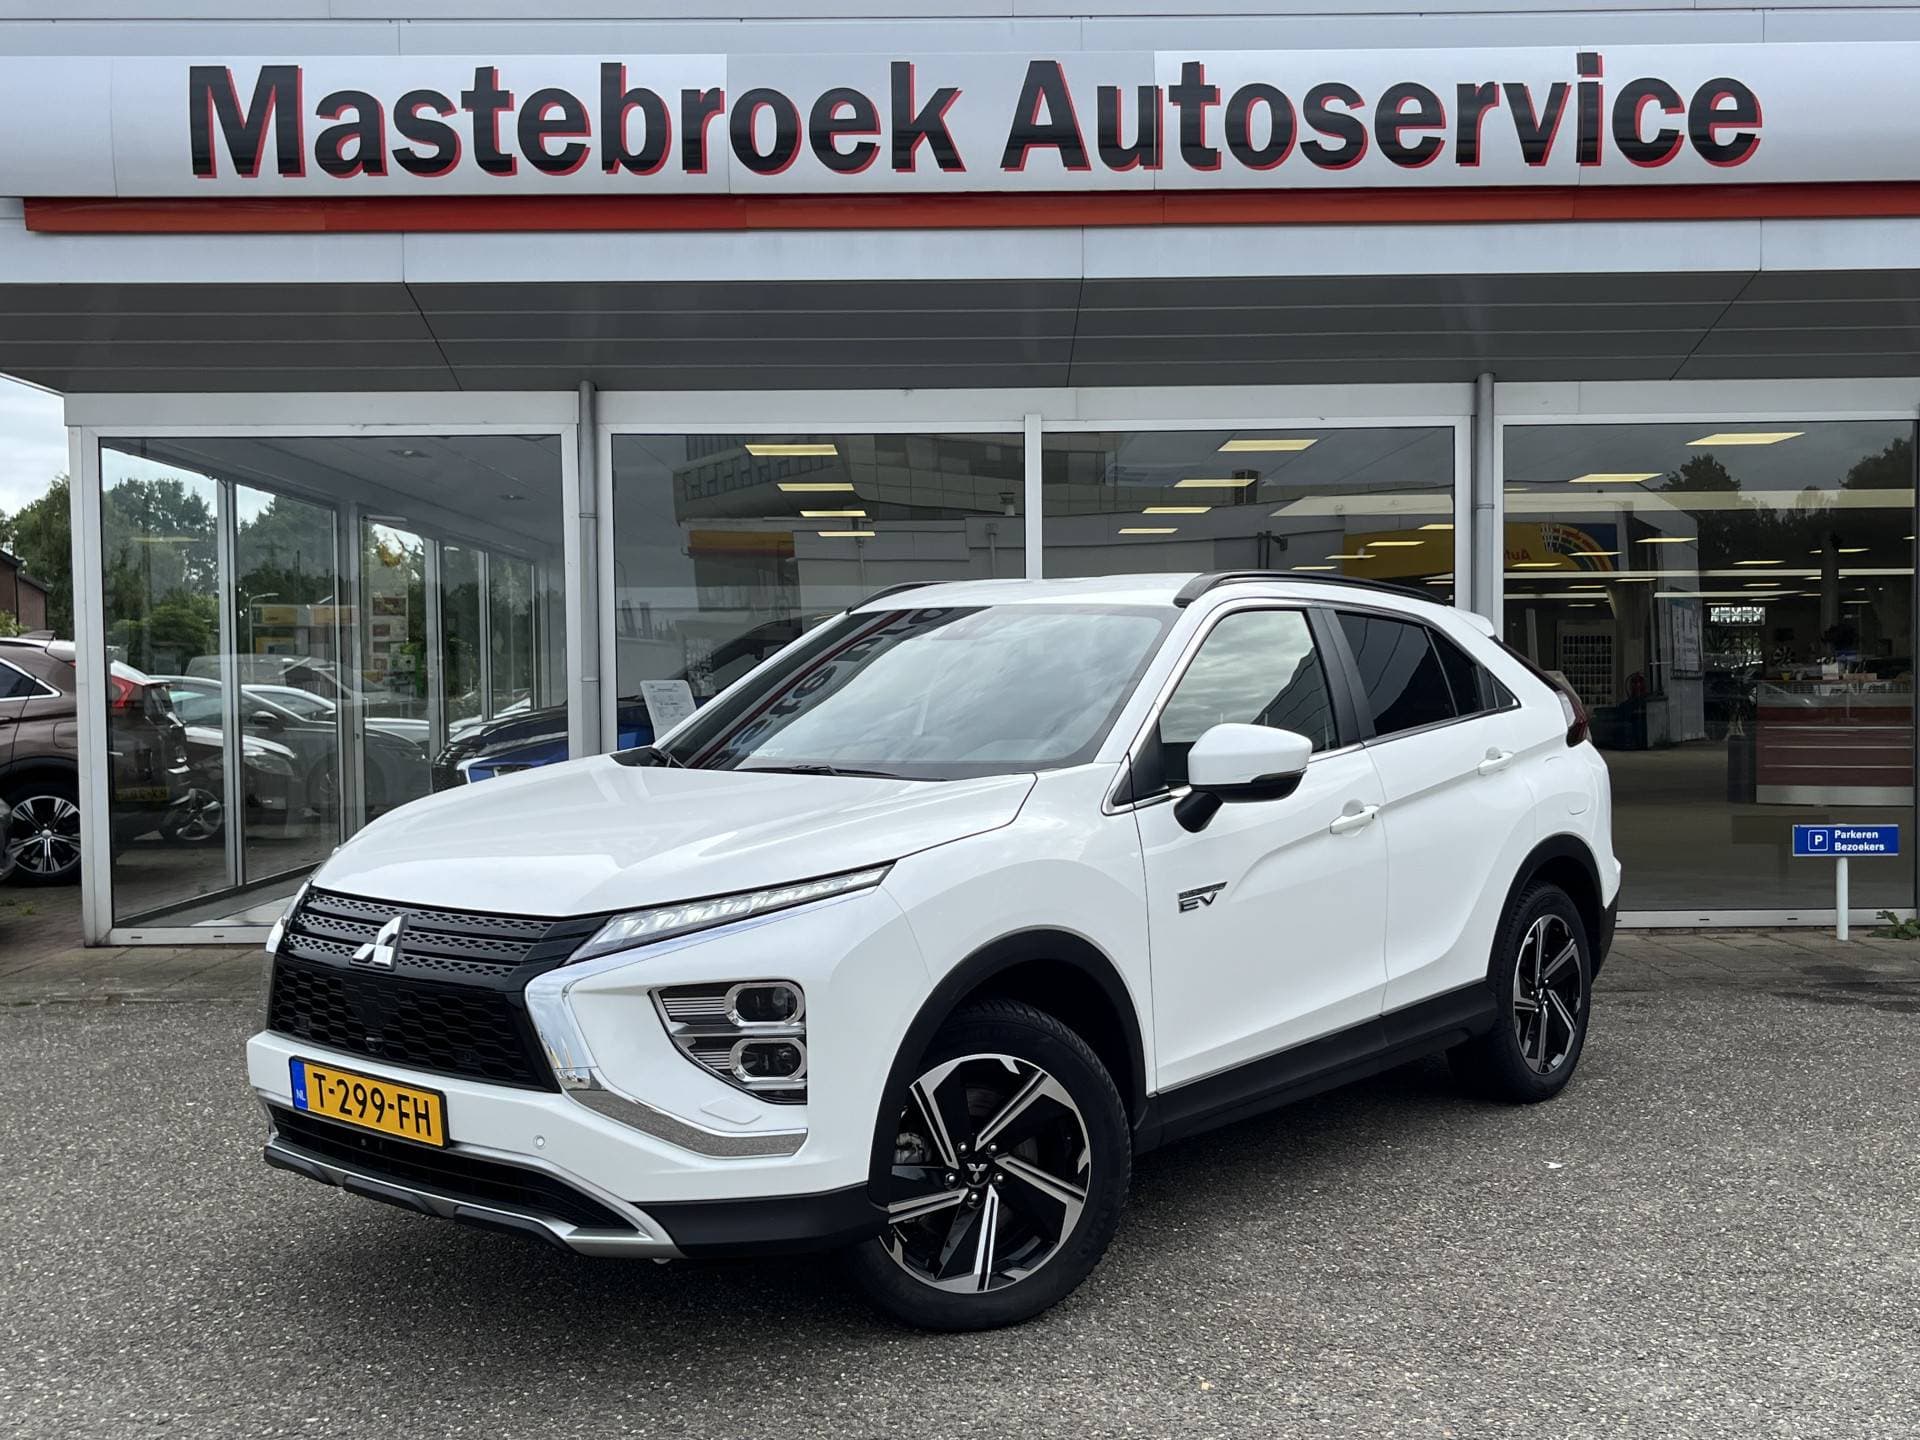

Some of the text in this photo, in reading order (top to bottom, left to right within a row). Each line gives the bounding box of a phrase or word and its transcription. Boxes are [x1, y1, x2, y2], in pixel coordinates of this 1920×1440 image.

[189, 51, 1763, 179] Mastebroek Autoservice
[1814, 834, 1823, 846] P
[1834, 830, 1879, 839] Parkeren
[1834, 842, 1885, 851] Bezoekers
[1178, 890, 1218, 914] EV
[312, 1072, 432, 1137] T-299-FH
